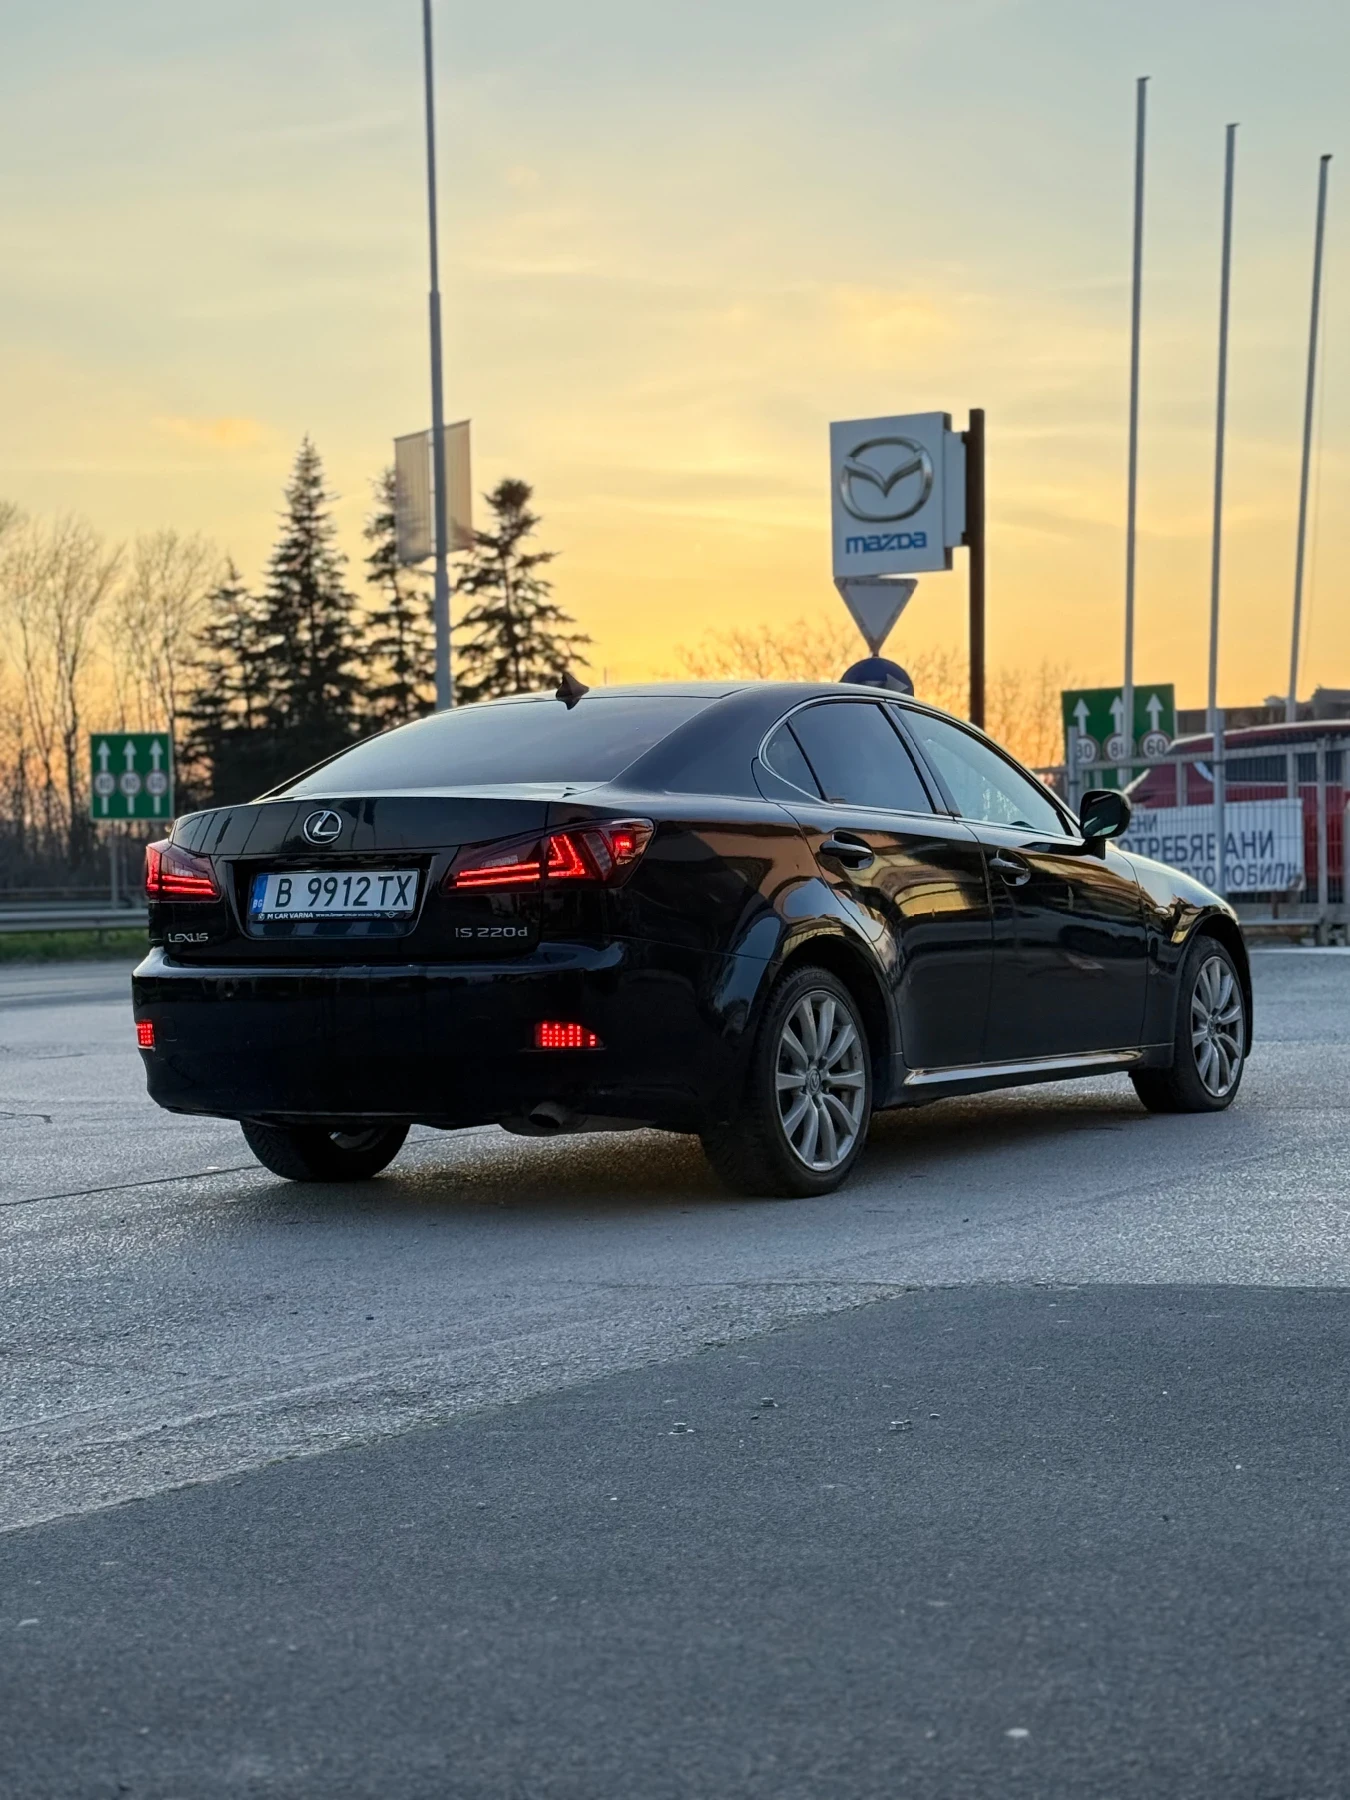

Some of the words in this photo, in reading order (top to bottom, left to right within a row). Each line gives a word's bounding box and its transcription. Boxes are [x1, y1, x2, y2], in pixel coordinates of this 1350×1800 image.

[845, 531, 928, 554] mazda
[1127, 812, 1158, 834] ЕНИ
[275, 878, 293, 908] B
[307, 876, 371, 907] 9912
[377, 875, 413, 906] TX
[252, 899, 264, 909] BG
[167, 932, 209, 943] LEXUS
[455, 927, 473, 938] IS
[476, 926, 529, 938] 220d
